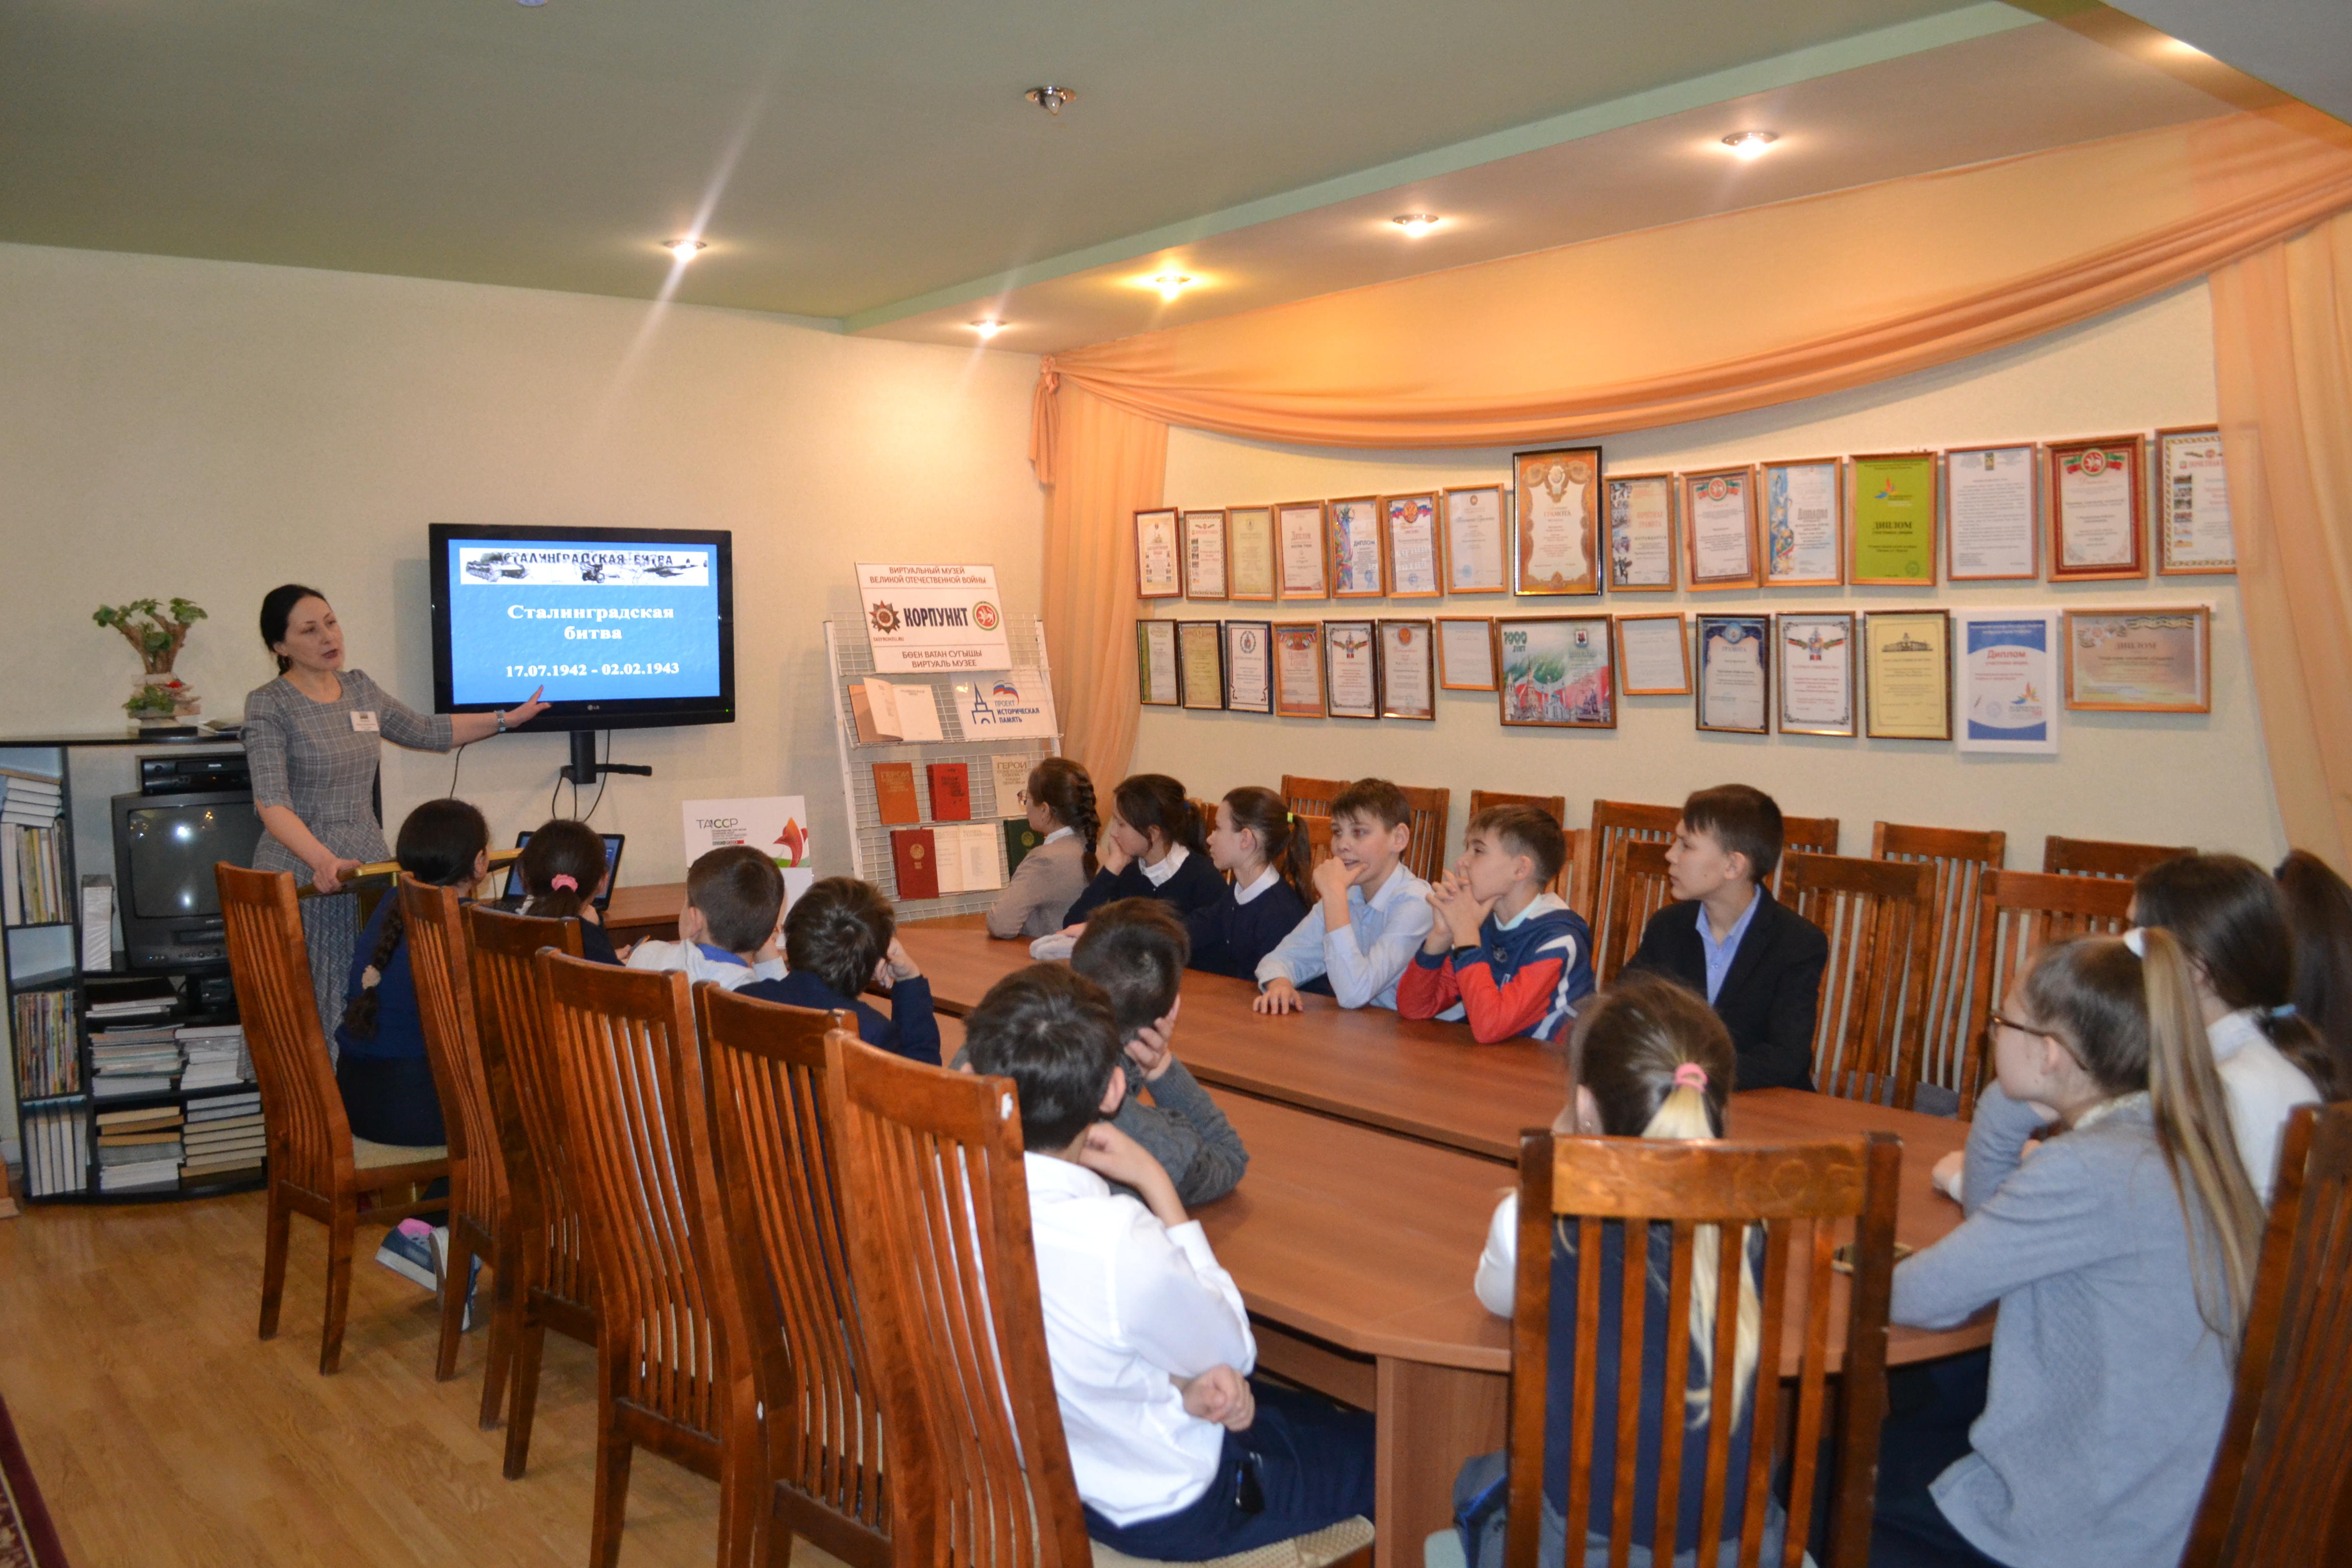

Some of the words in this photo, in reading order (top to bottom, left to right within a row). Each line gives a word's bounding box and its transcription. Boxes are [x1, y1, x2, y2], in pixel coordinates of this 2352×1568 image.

[889, 566, 940, 575] ВИРТУАЛЬНЫЙ
[942, 566, 965, 575] МУЗЕЙ
[870, 575, 904, 583] ВЕЛИКОЙ
[905, 575, 960, 584] ОТЕЧЕСТВЕННОЙ
[962, 576, 987, 584] ВОЙНЫ
[507, 604, 674, 622] Сталинградская
[903, 607, 969, 627] КОРПУНКТ
[564, 626, 623, 640] битва
[948, 650, 982, 658] СУГЫШЫ
[1987, 649, 2026, 659] Диплом
[912, 660, 951, 669] ВИРТУАЛЬ
[952, 659, 977, 668] МУЗЕЕ
[506, 665, 587, 677] 17.07.1942
[601, 663, 680, 675] 02.02.1943
